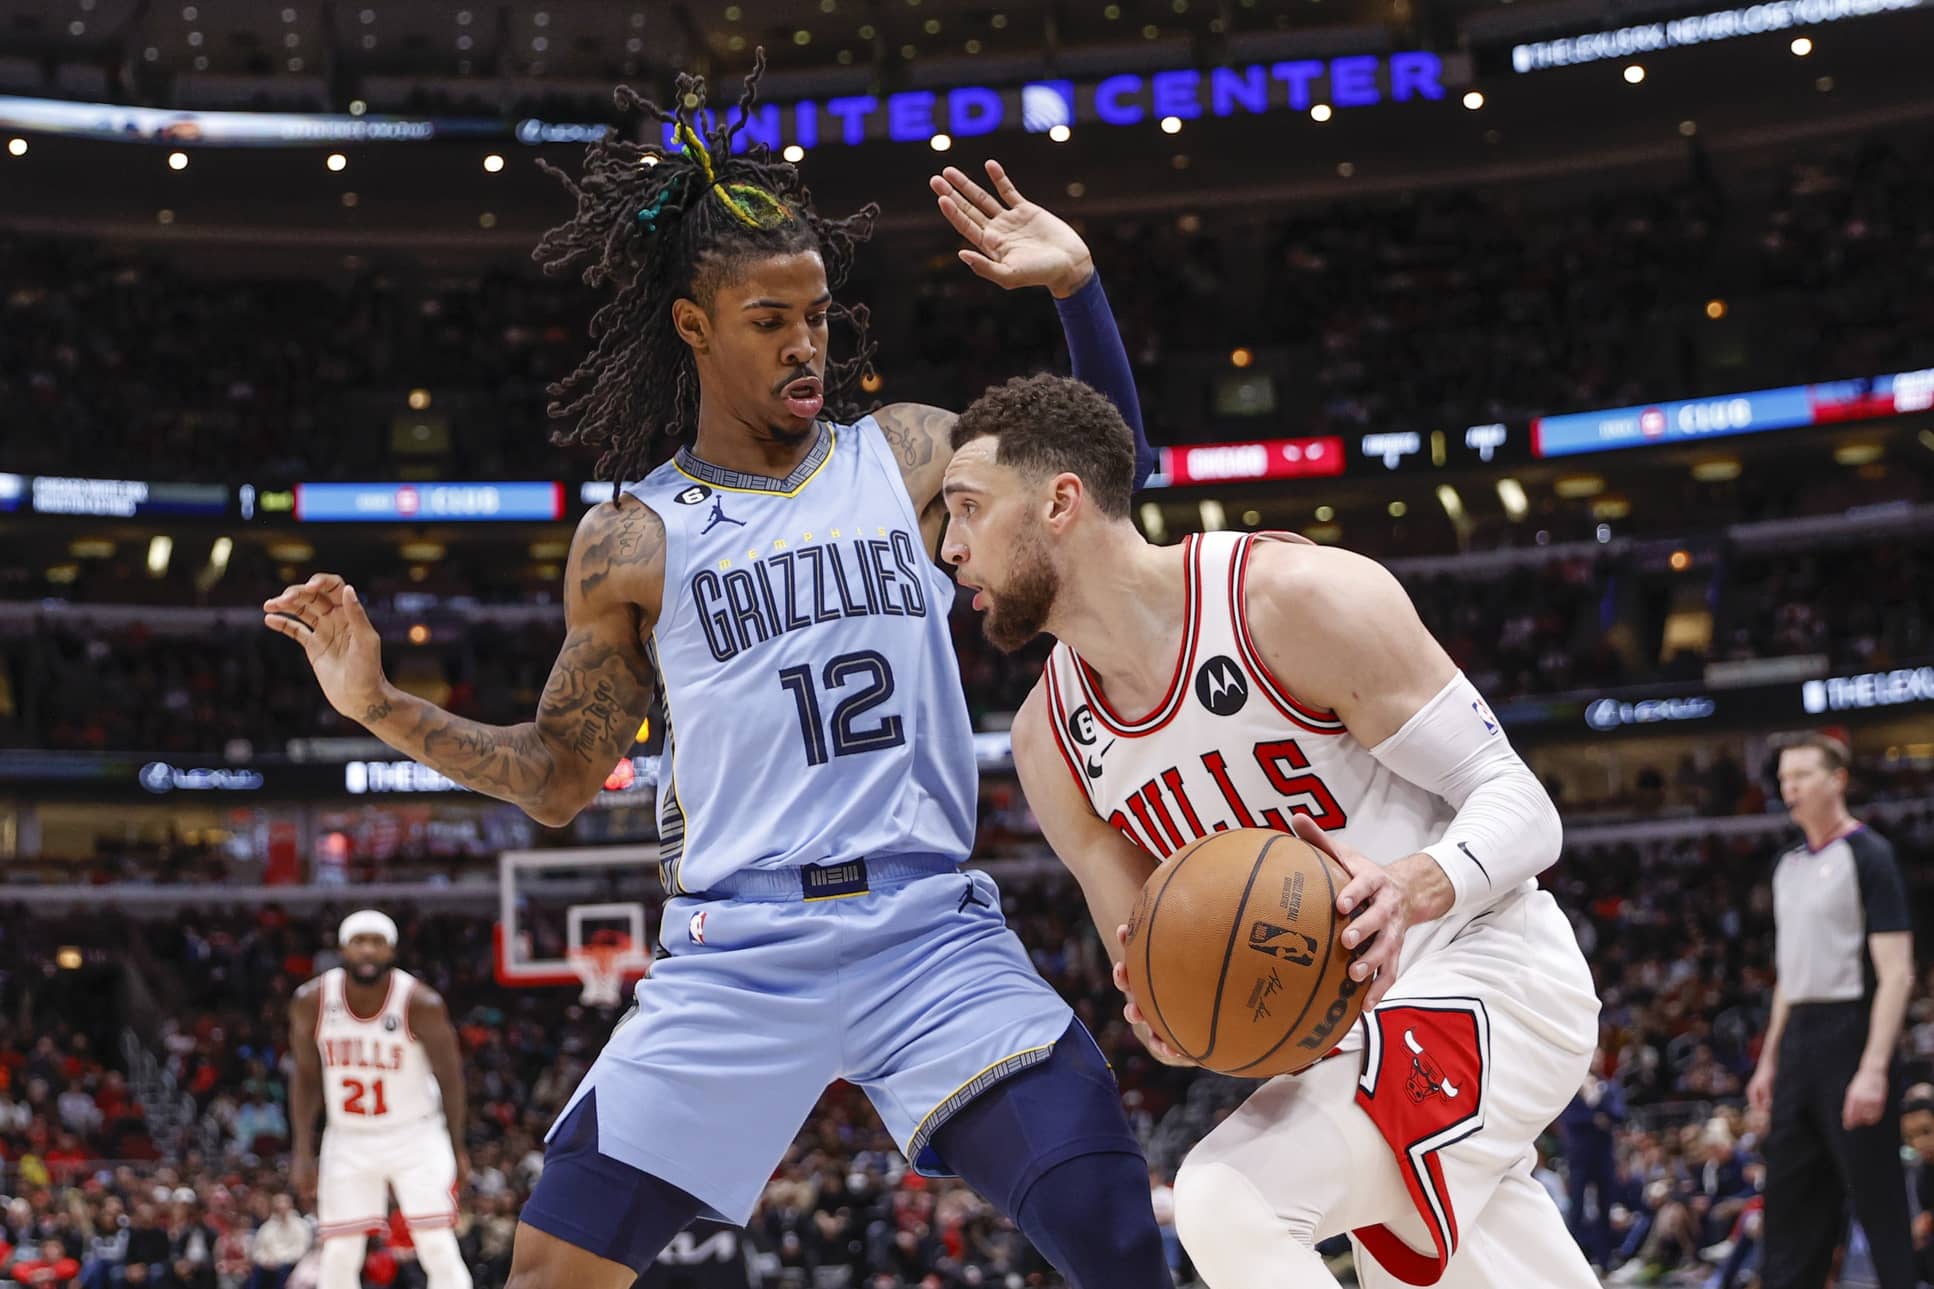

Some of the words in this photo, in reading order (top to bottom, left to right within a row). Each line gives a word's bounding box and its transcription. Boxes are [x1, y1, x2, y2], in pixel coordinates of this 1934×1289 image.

[1094, 51, 1445, 125] CENTER
[682, 487, 704, 504] 6
[691, 529, 927, 663] GRIZZLIES
[778, 649, 906, 767] 12
[341, 1078, 388, 1116] 21
